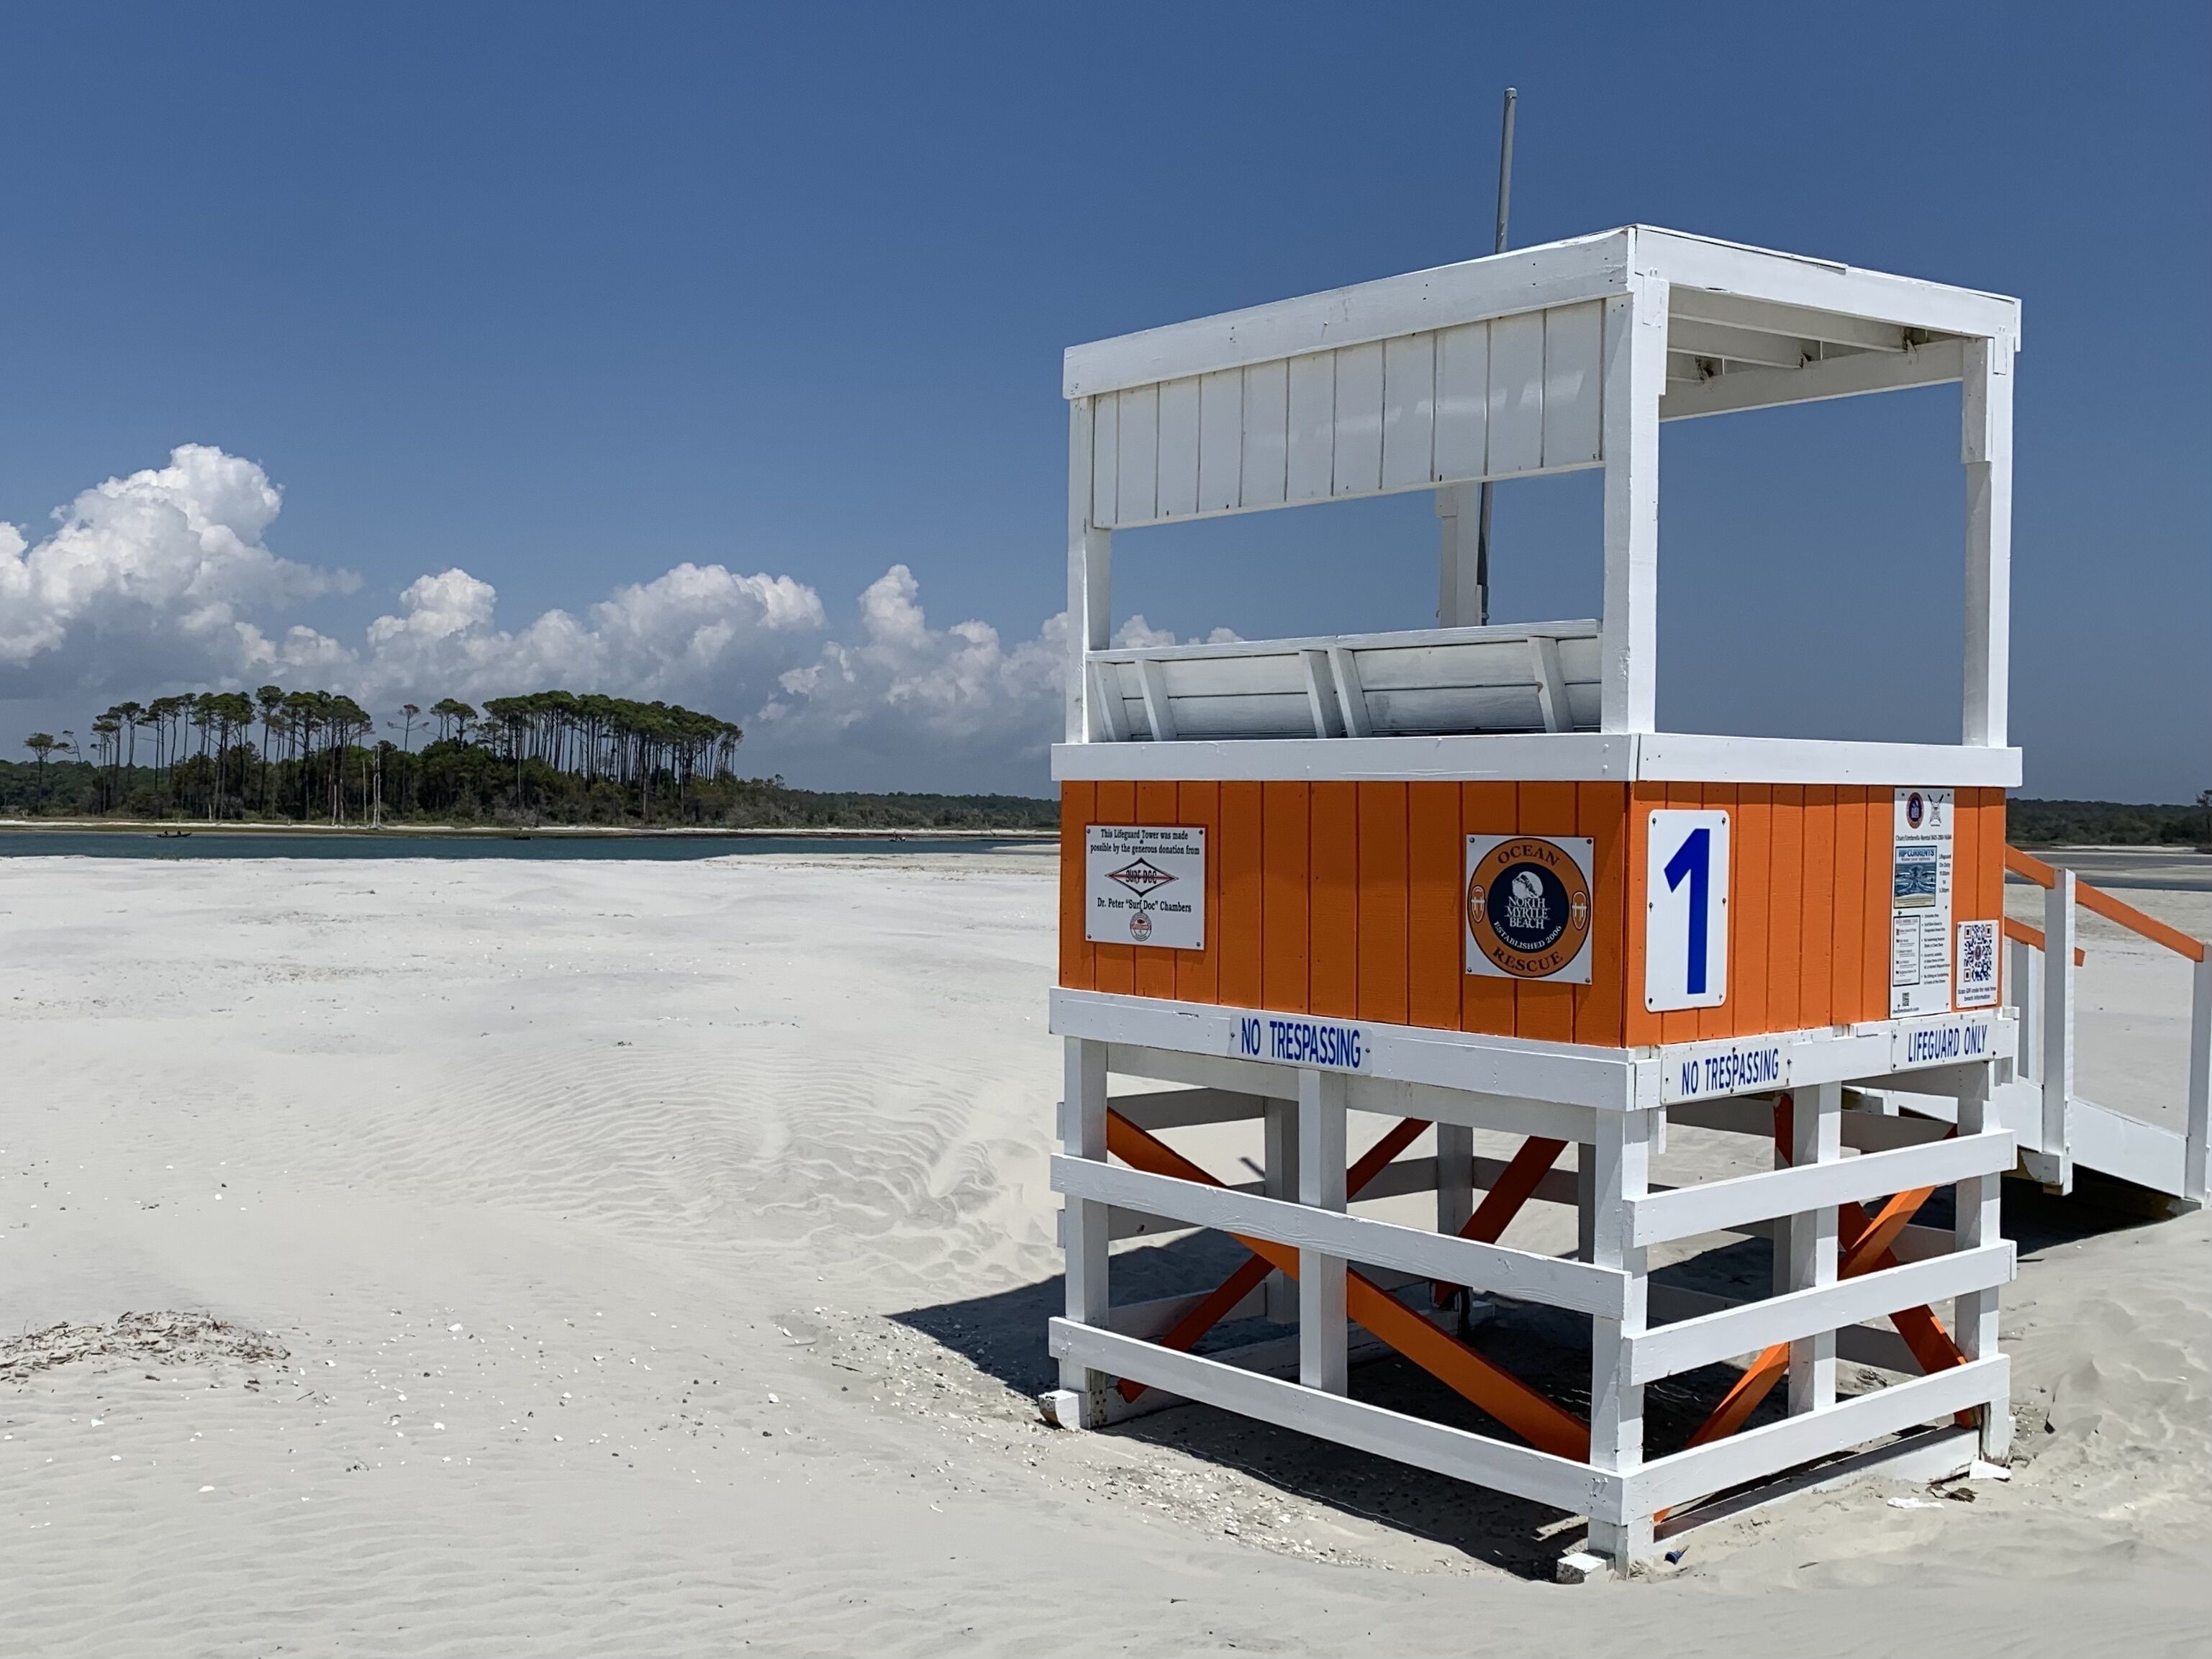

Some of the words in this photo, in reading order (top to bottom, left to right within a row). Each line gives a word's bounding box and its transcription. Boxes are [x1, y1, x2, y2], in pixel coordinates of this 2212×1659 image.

[1101, 829, 1112, 838] This
[1114, 830, 1140, 841] Lifeguard
[1141, 830, 1159, 840] Tower
[1172, 830, 1188, 840] made
[1090, 842, 1112, 854] possible
[1113, 843, 1120, 855] by
[1121, 844, 1130, 853] the
[1132, 846, 1157, 855] generous
[1159, 845, 1184, 854] donation
[1186, 845, 1200, 855] from
[1497, 845, 1560, 866] OCEAN
[1143, 871, 1157, 884] DOC
[1097, 897, 1106, 907] Dr.
[1108, 899, 1124, 909] Peter
[1160, 901, 1192, 912] Chambers
[1508, 896, 1546, 908] NORTH
[1506, 906, 1548, 920] MYRTLE
[1664, 829, 1710, 994] 1
[1509, 917, 1544, 929] BEACH
[1494, 921, 1545, 950] ESTABLISHED
[1546, 925, 1561, 944] 2006
[1492, 946, 1563, 971] RESCUE
[1241, 1017, 1261, 1055] NO
[1269, 1021, 1361, 1068] TRESPASSING
[1908, 1027, 1959, 1062] LIFEGUARD
[1964, 1024, 1987, 1055] ONLY
[1682, 1060, 1698, 1096] NO
[1705, 1047, 1779, 1091] TRESPASSING
